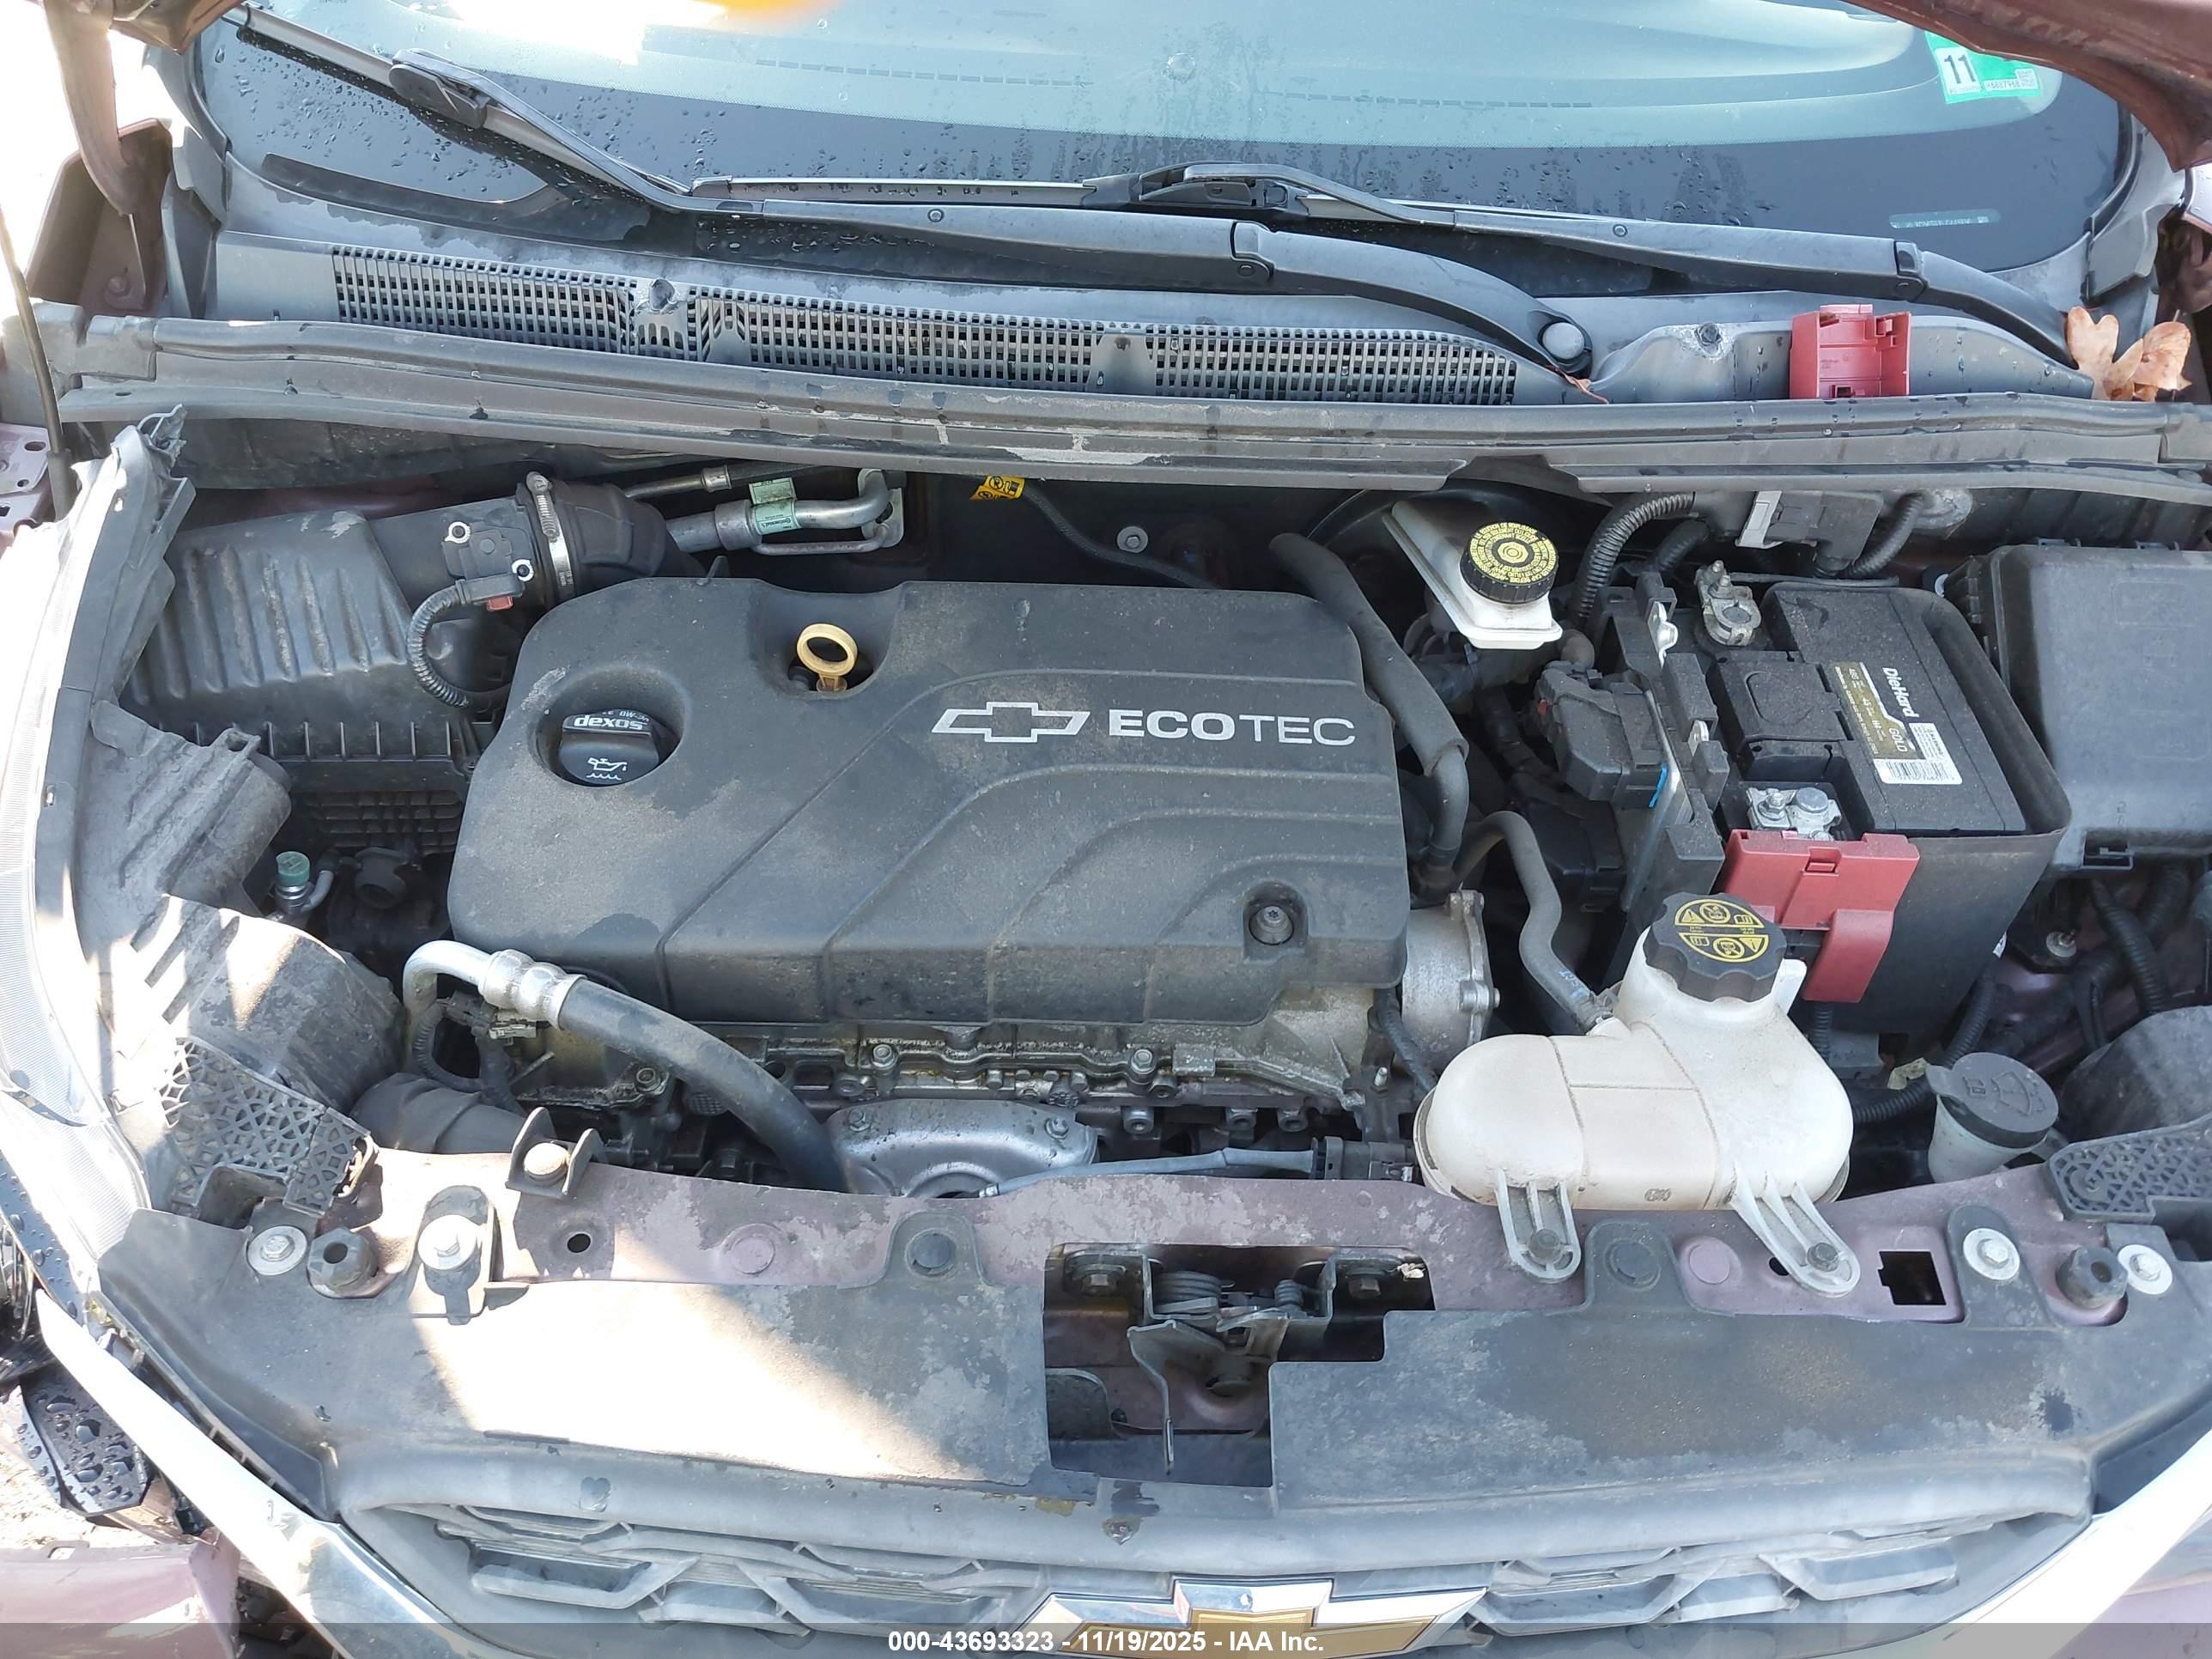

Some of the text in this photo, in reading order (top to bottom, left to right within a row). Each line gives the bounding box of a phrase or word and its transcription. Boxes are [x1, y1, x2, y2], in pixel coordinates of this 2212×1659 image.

[1944, 54, 1977, 84] 11
[1881, 667, 1920, 718] DieHard
[574, 714, 647, 730] dexos
[1109, 708, 1357, 746] ECOTEC
[1888, 727, 1908, 752] GOLD
